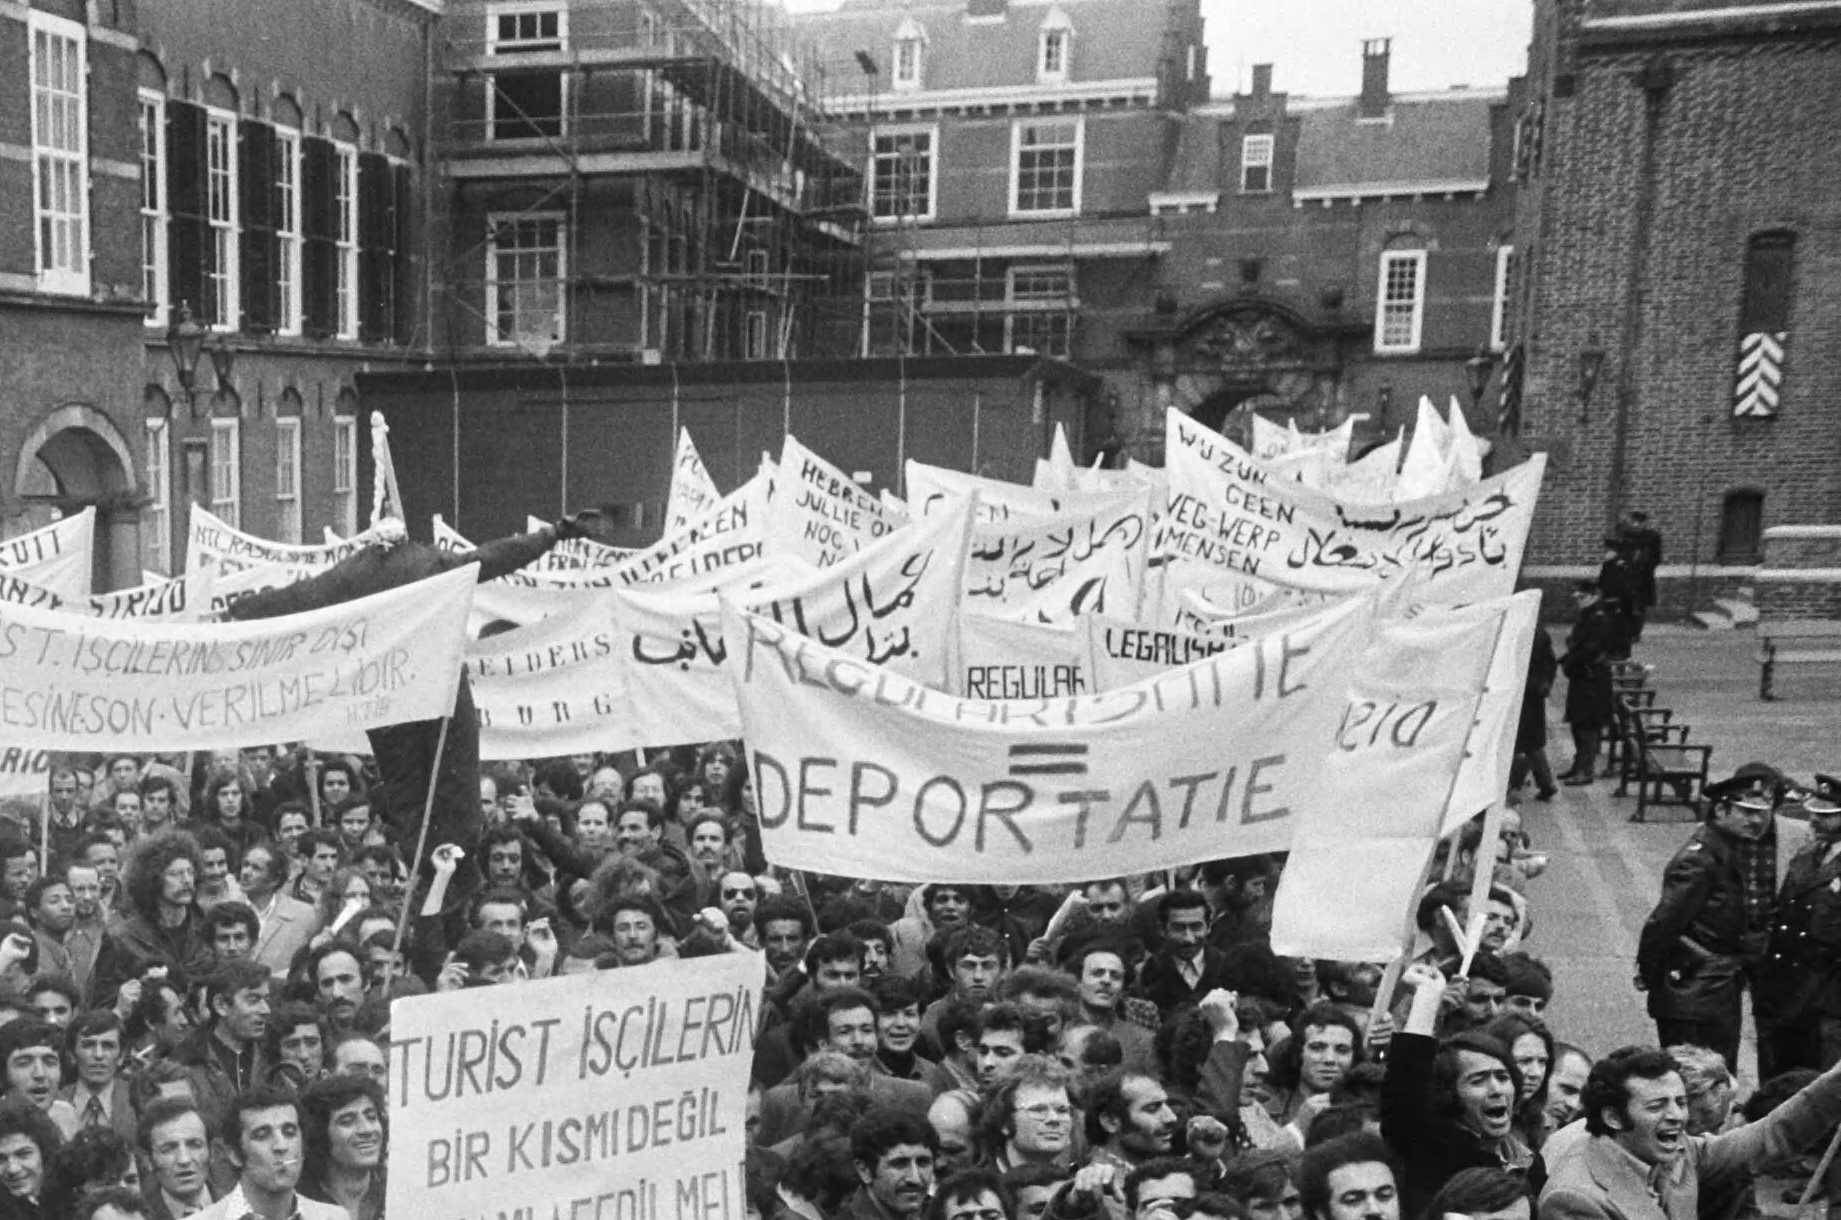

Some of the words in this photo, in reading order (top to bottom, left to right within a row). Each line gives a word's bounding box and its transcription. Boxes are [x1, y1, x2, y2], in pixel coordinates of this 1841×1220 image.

[795, 490, 861, 530] JULLIE
[1226, 482, 1296, 524] GEEN
[754, 754, 1290, 854] DEPORTATIE
[427, 1128, 491, 1189] BİR
